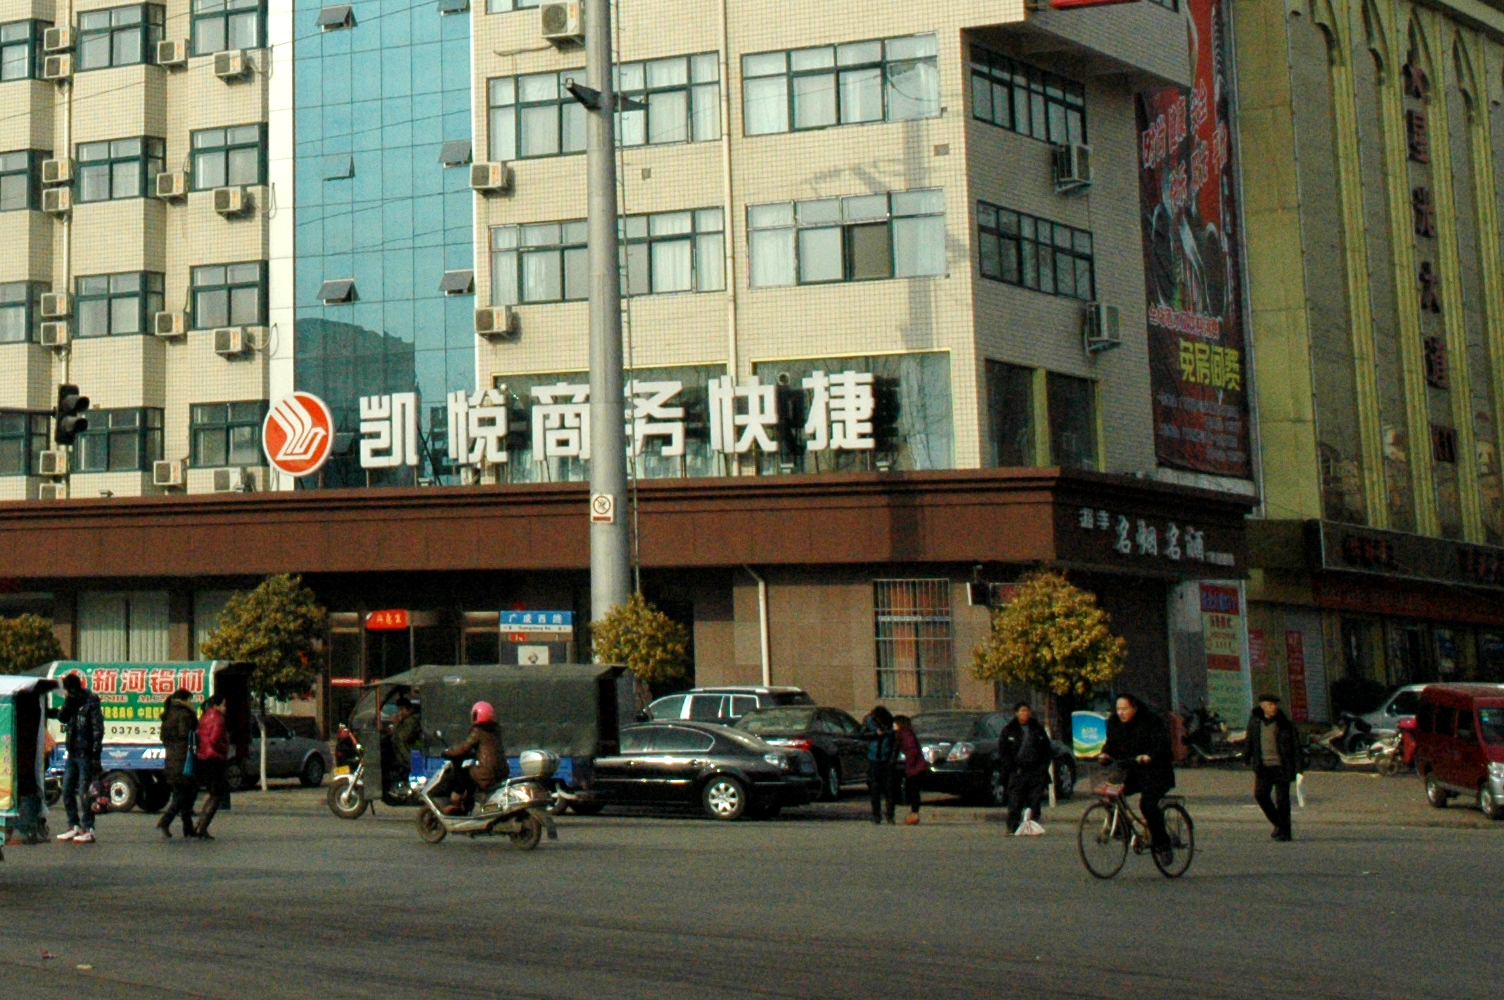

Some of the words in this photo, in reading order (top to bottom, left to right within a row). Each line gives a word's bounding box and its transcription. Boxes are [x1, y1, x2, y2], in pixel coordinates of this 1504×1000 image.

[1179, 337, 1241, 391] 免房间费
[359, 370, 876, 468] 凯悦商务快捷
[92, 668, 206, 694] 新河铝材
